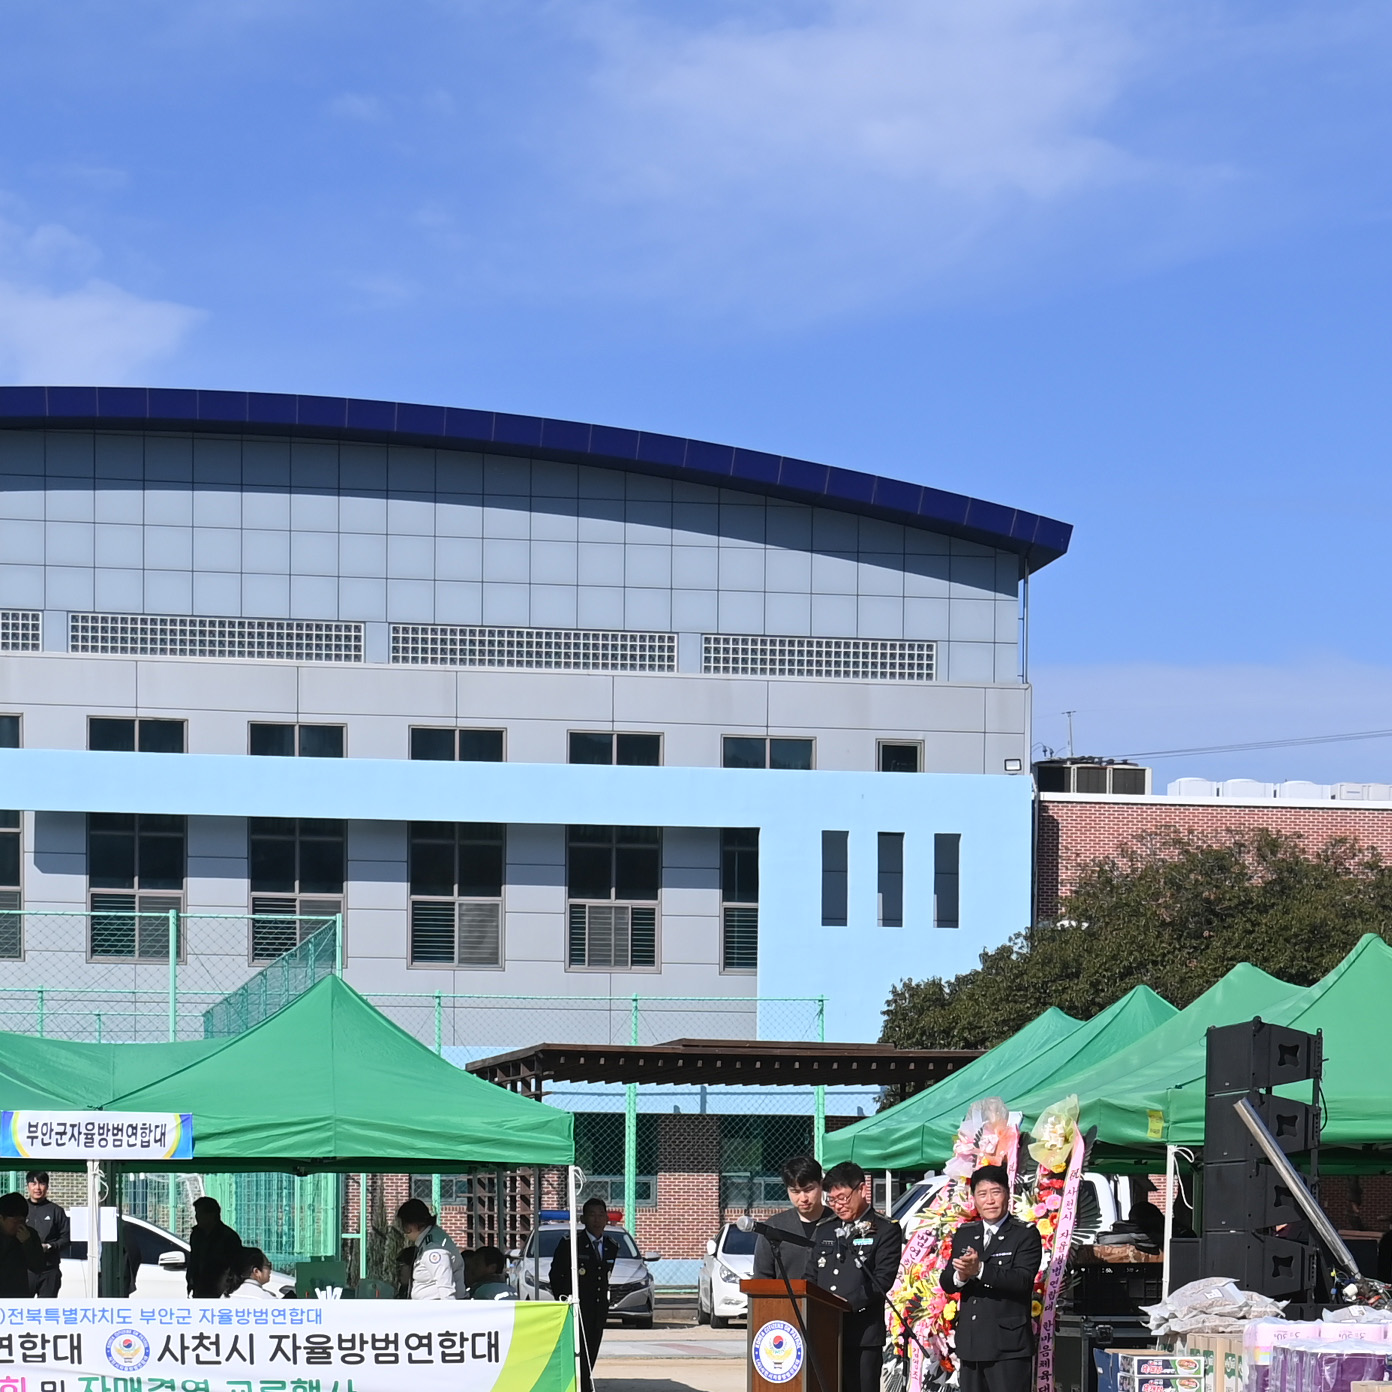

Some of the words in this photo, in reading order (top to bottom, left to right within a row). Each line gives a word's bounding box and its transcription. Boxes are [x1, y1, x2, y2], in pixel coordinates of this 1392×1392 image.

[26, 1121, 167, 1148] 부안군자율방범연합대
[139, 1308, 192, 1325] 부안군
[199, 1308, 322, 1325] 자율방범연합대
[157, 1331, 254, 1365] 사천시
[269, 1331, 500, 1366] 자율방범연합대
